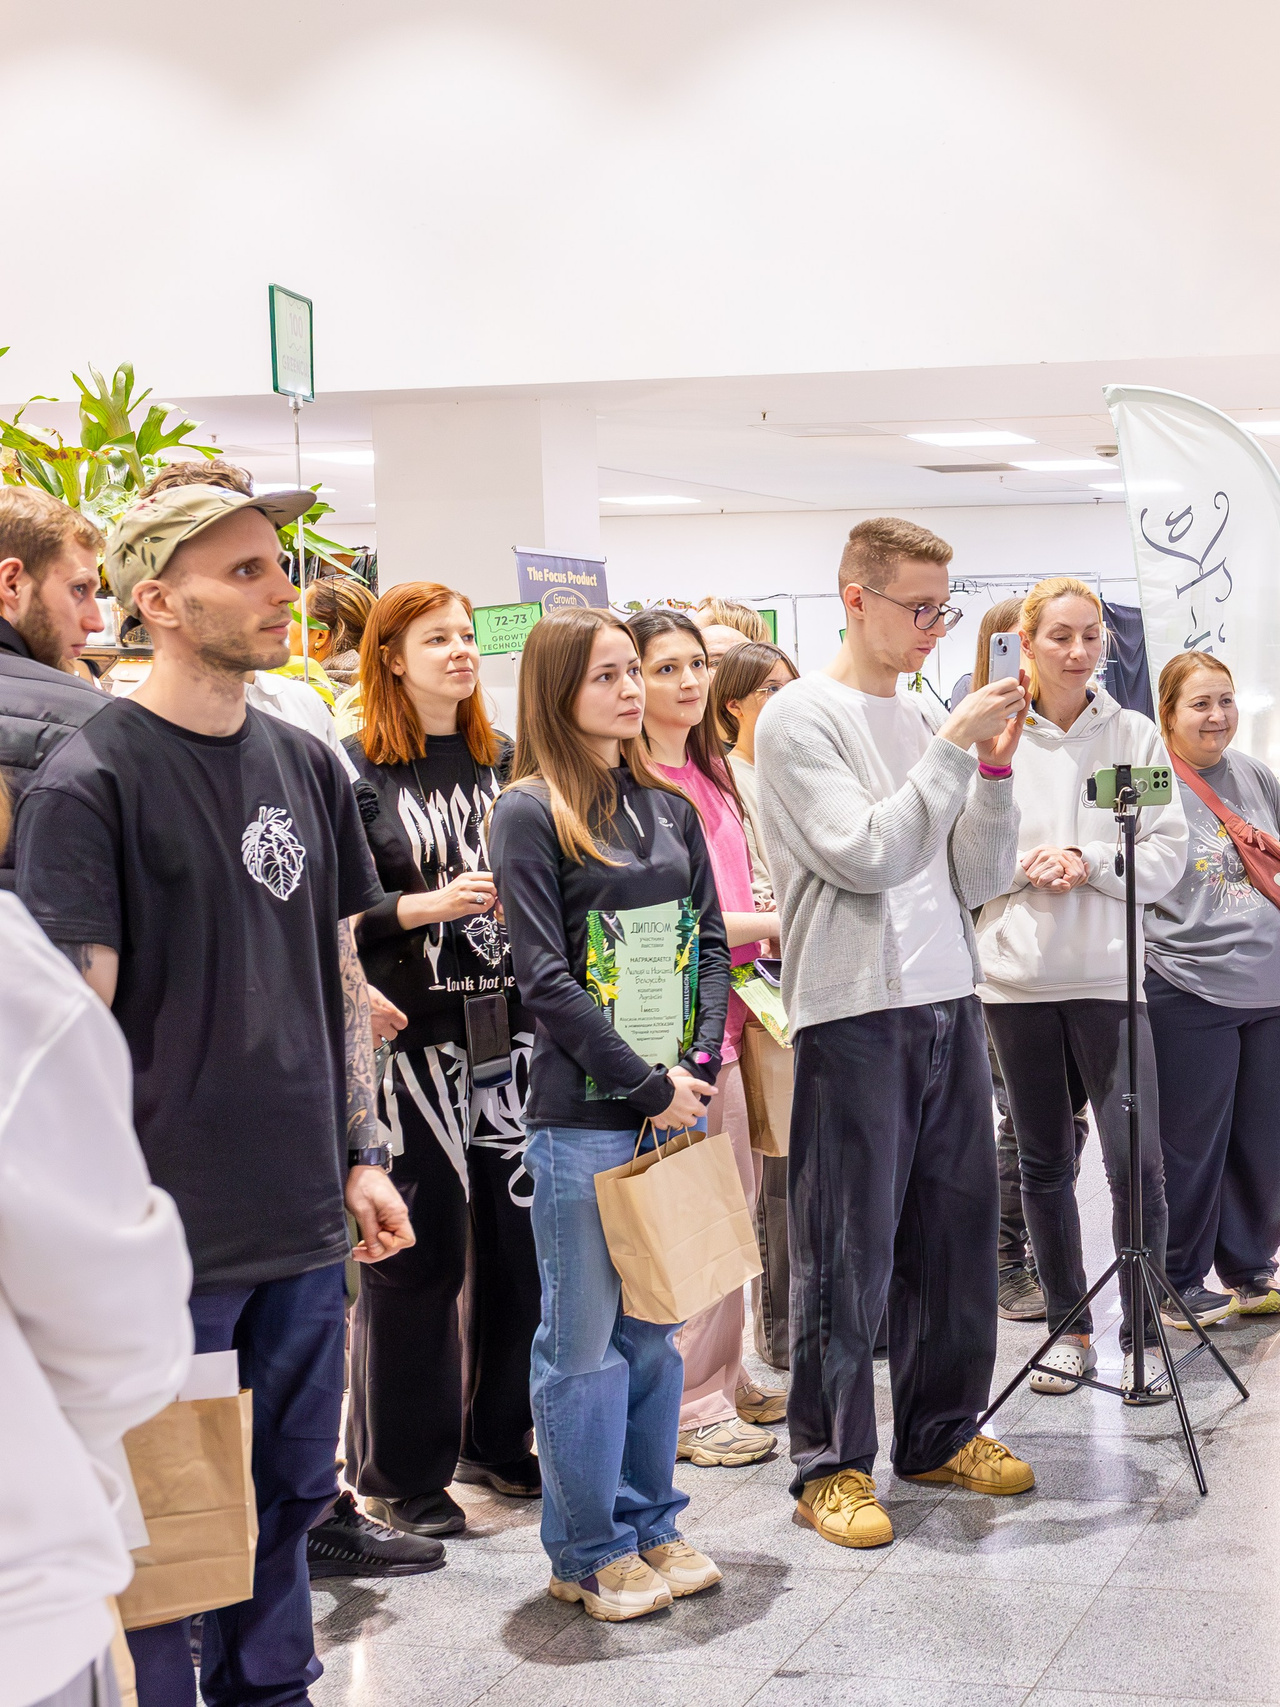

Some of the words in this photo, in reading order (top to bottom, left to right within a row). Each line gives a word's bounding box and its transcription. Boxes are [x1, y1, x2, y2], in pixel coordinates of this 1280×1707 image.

[527, 567, 543, 581] The
[543, 569, 566, 583] Focus
[568, 571, 597, 587] Product
[553, 593, 577, 606] Growth
[495, 613, 527, 626] 72-73
[630, 922, 671, 933] ДИПЛОМ
[478, 975, 500, 992] hot
